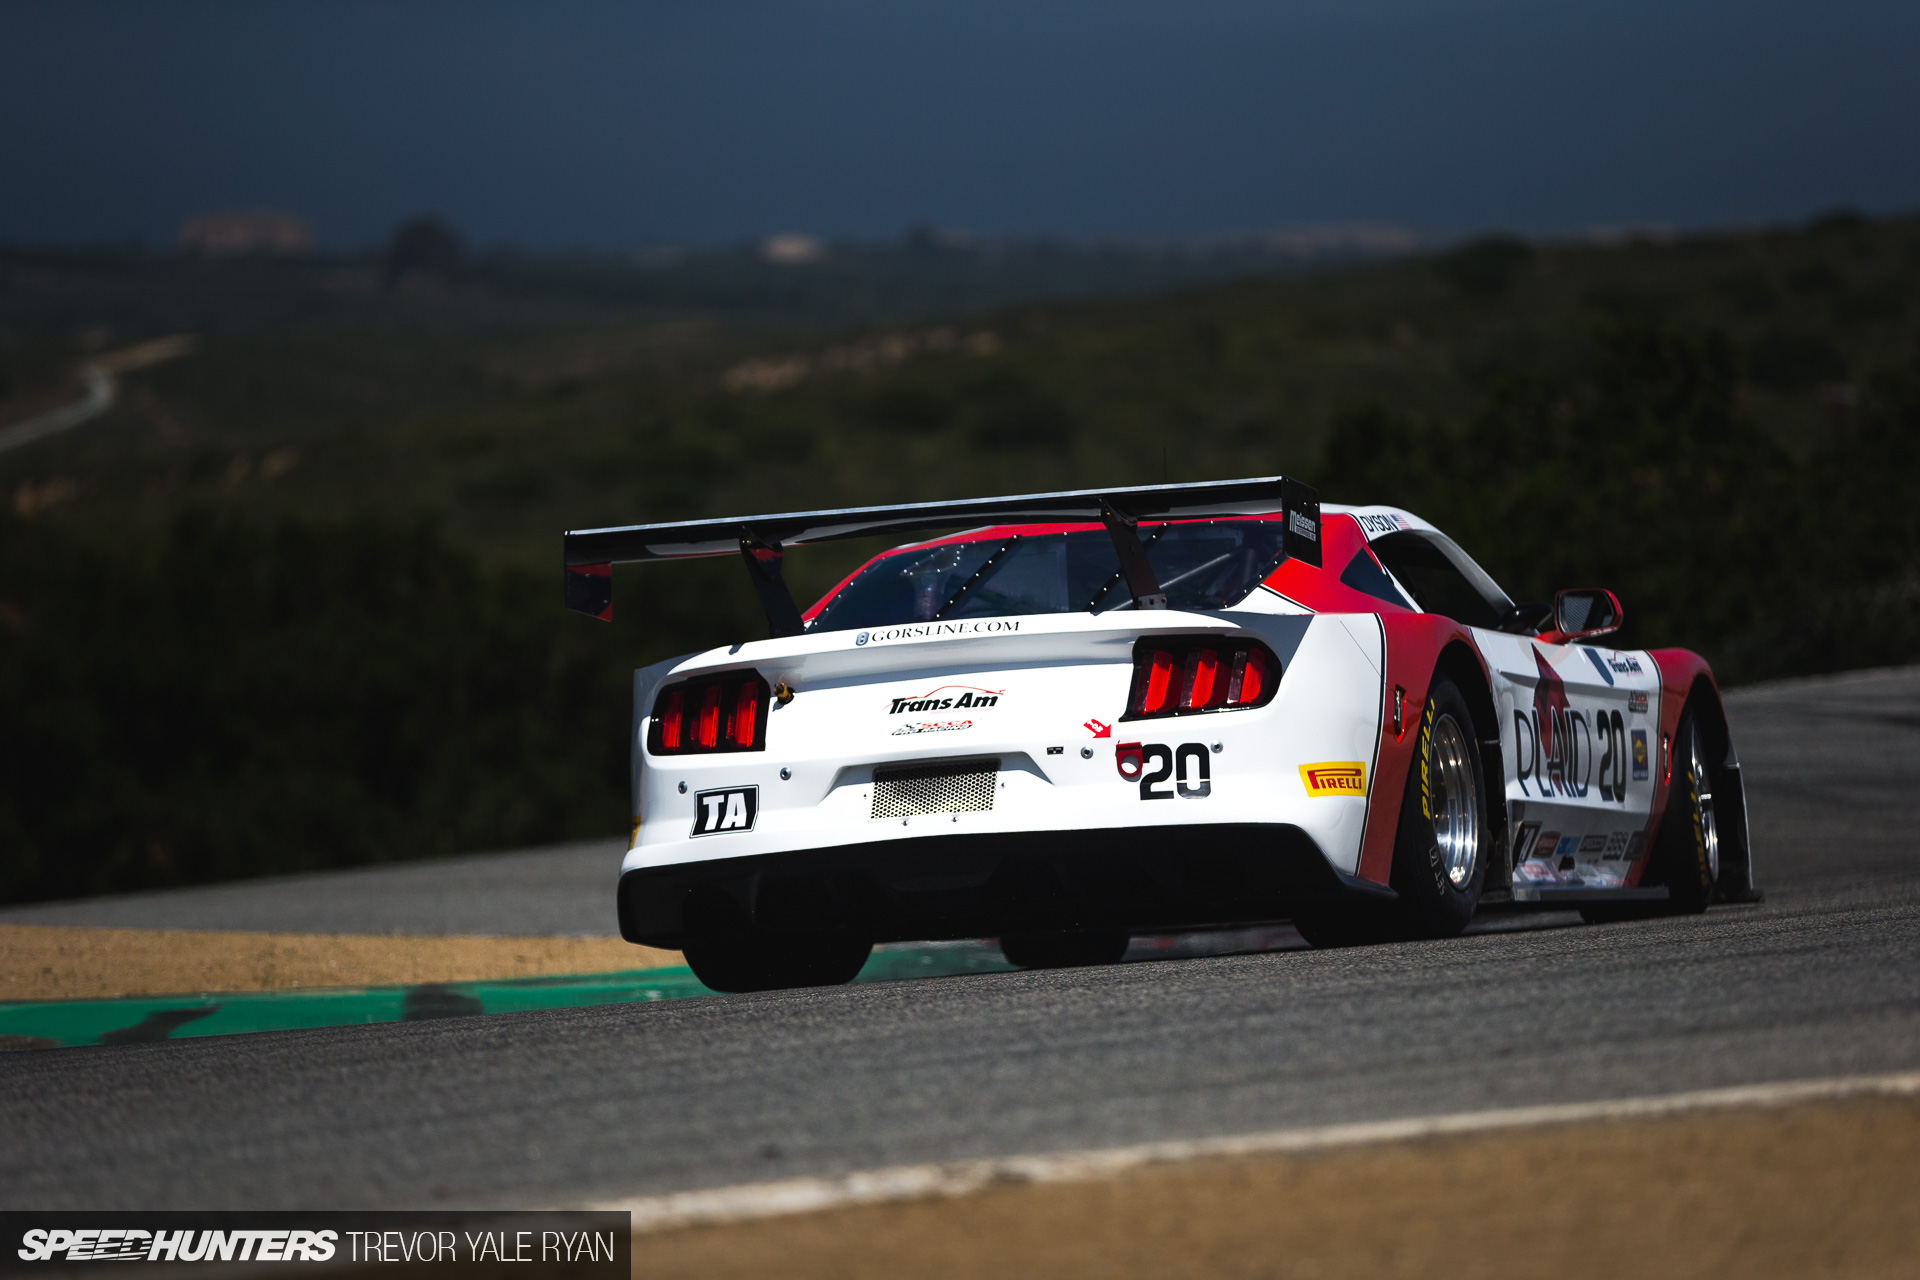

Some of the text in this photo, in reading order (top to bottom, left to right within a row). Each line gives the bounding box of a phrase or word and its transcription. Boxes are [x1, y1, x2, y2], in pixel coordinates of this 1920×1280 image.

[1290, 509, 1316, 533] Meissen
[1359, 513, 1399, 532] DYSON
[871, 620, 1020, 643] GORSLINE.COM
[889, 697, 953, 715] Trans
[953, 692, 998, 709] Am
[1421, 698, 1435, 820] PIRELLI
[1514, 708, 1592, 798] PLAID
[1597, 709, 1627, 803] 20
[1140, 742, 1212, 800] 20
[1307, 768, 1362, 790] PIRELLI
[702, 792, 748, 831] TA
